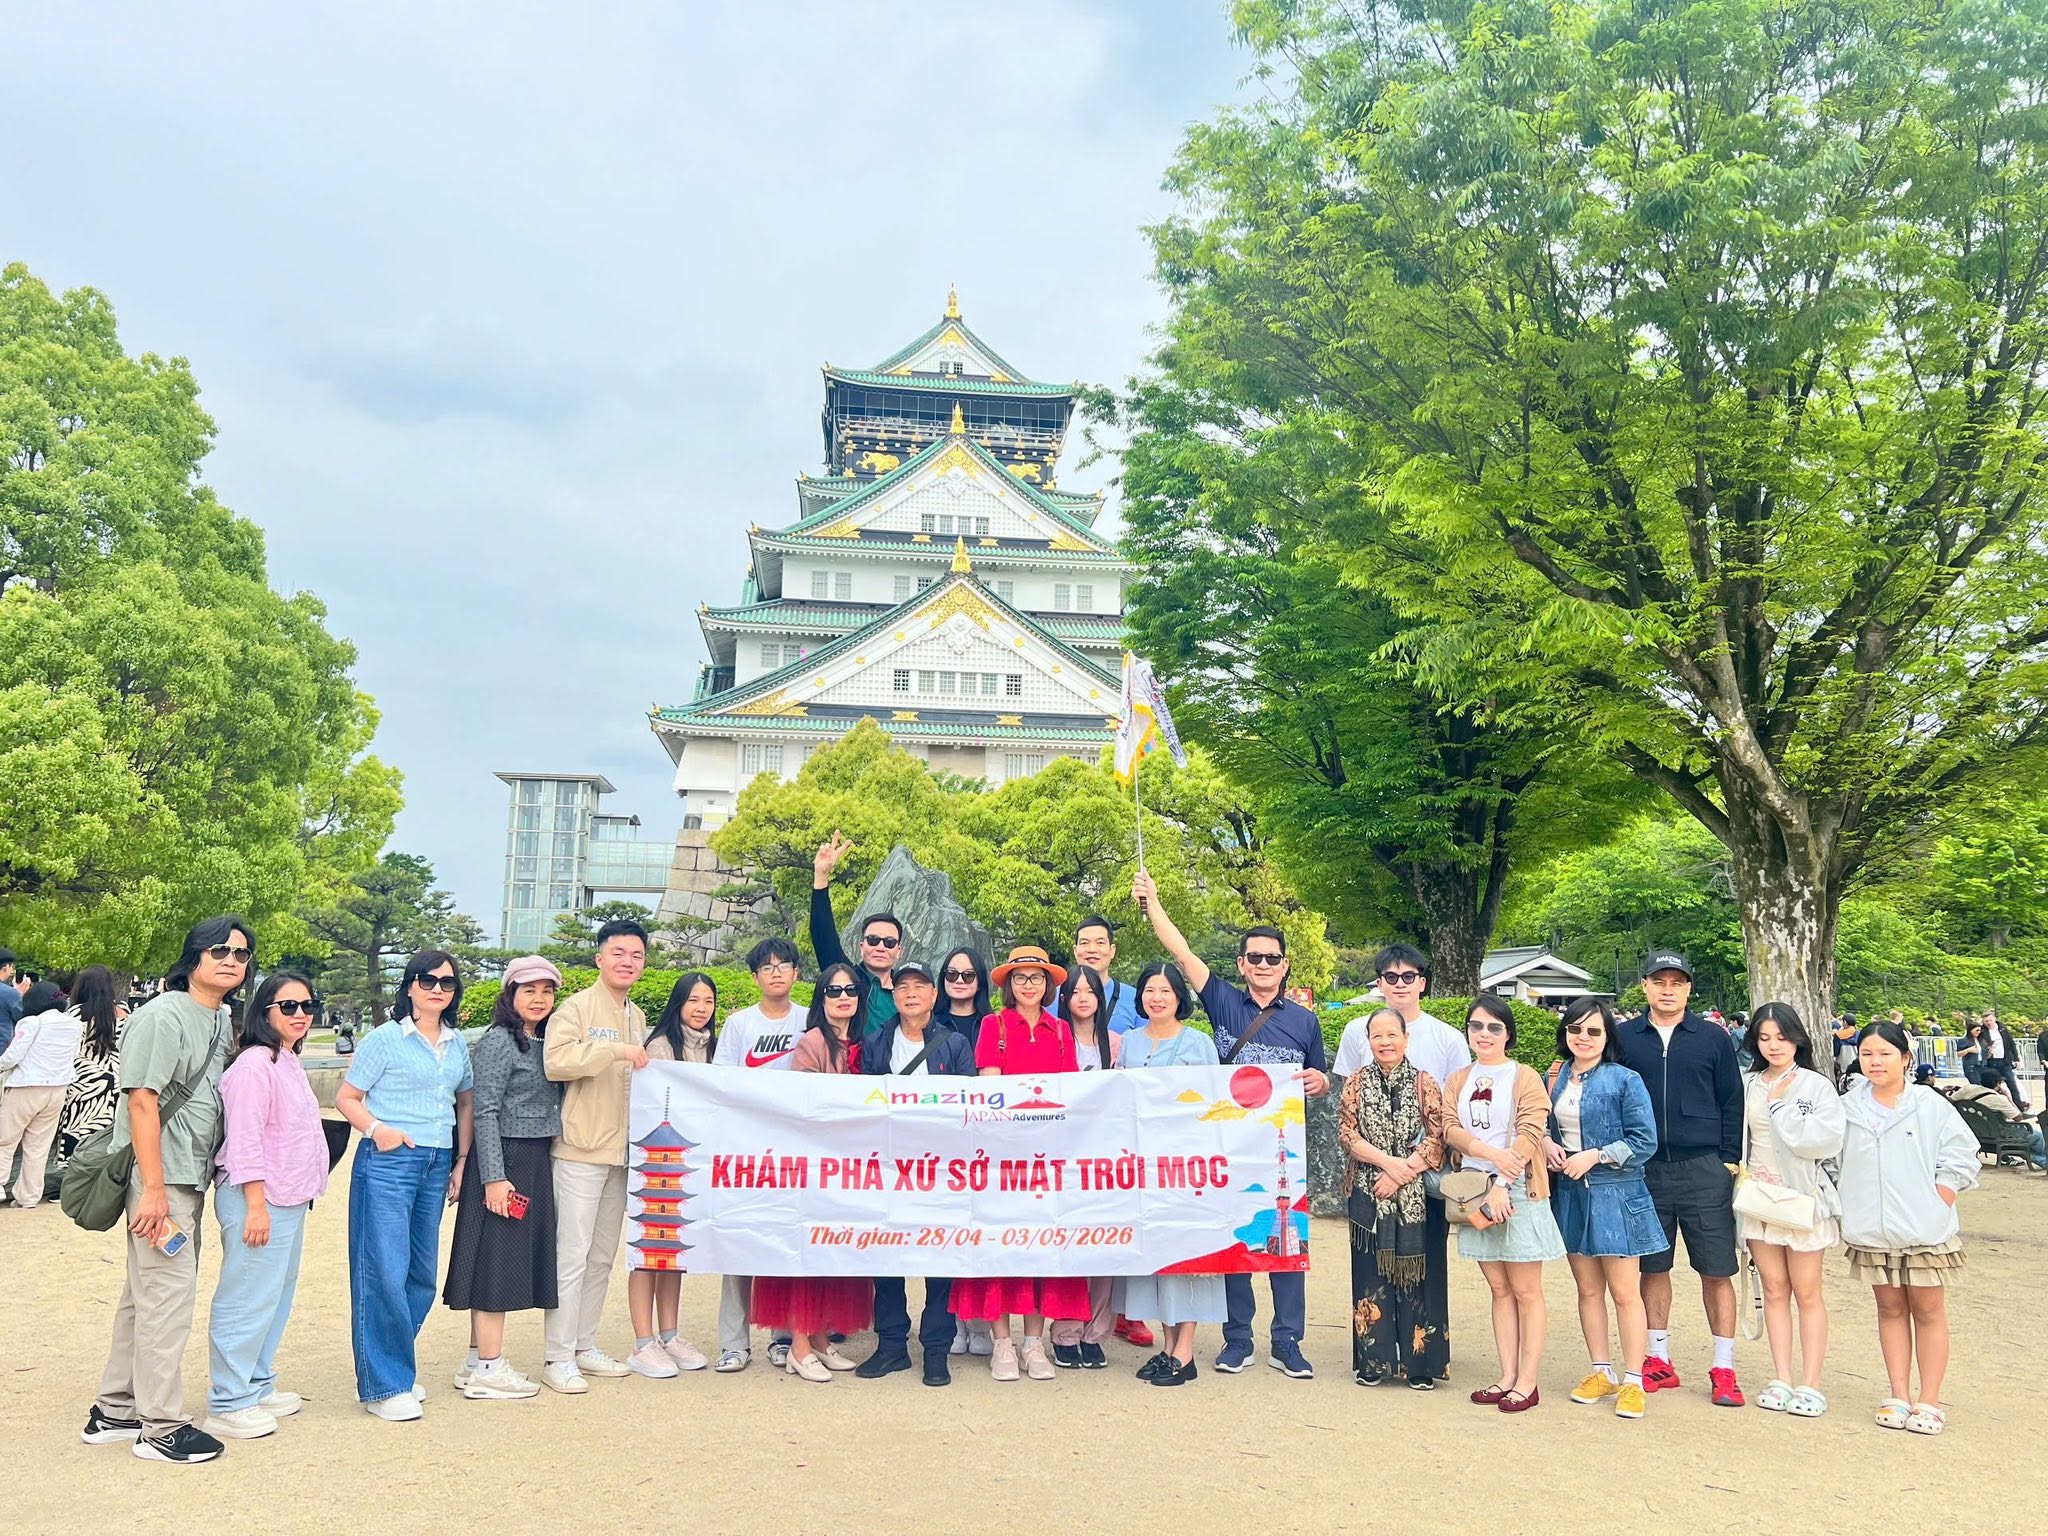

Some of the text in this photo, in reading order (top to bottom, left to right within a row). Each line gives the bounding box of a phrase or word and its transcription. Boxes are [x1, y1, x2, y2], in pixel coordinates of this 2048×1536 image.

[587, 1026, 619, 1041] SKATE
[754, 1034, 793, 1053] NIKE
[863, 1087, 1006, 1109] Amazing
[1013, 1112, 1066, 1122] Adventures
[711, 1148, 1229, 1198] KHÁM PHÁ XỨ SỞ MẶT TRỜI MỌC
[809, 1225, 853, 1245] Thời
[856, 1227, 911, 1250] gian:
[916, 1226, 982, 1251] 28/04
[1001, 1226, 1133, 1251] 03/05/2026
